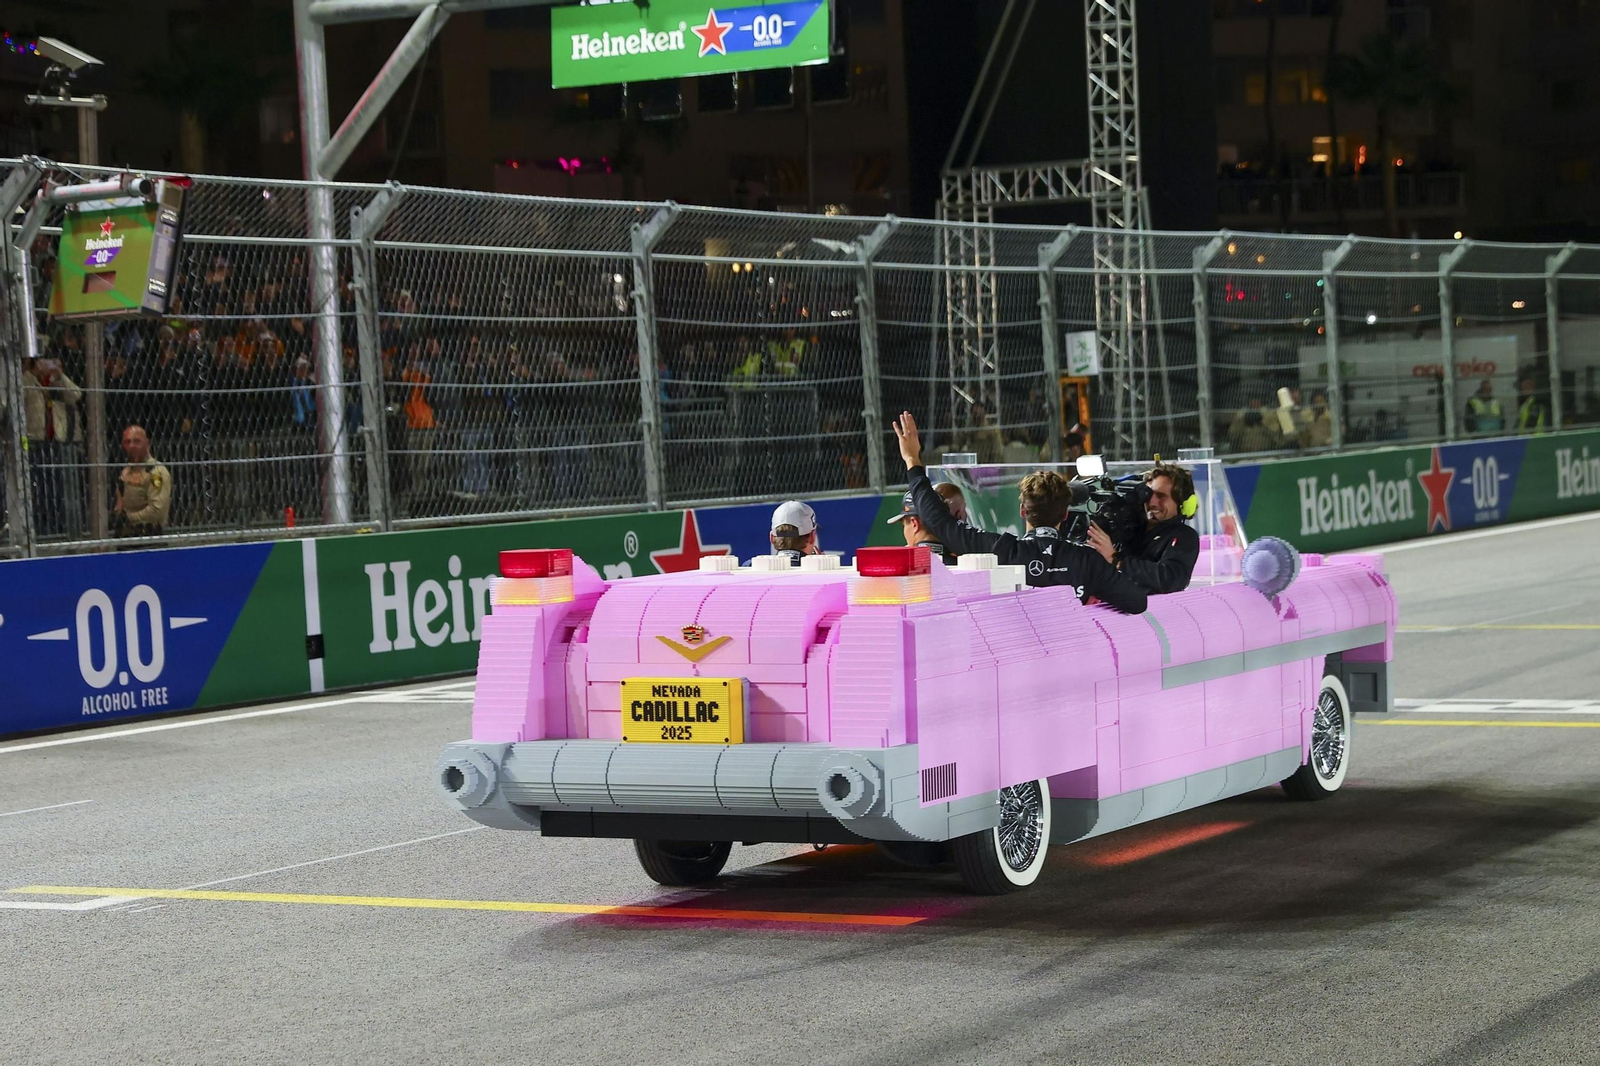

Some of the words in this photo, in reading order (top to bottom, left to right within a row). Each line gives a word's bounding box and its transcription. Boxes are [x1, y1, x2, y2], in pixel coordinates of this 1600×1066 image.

[752, 13, 783, 41] 0.0
[571, 27, 686, 60] Heineken
[85, 236, 123, 250] Heineken
[1298, 469, 1415, 536] Heineken
[75, 584, 165, 689] 0.0
[82, 691, 137, 716] ALCOHOL
[141, 686, 168, 707] FREE
[652, 685, 701, 697] NEVADA
[631, 700, 719, 723] CADILLAC
[661, 725, 692, 740] 2025
